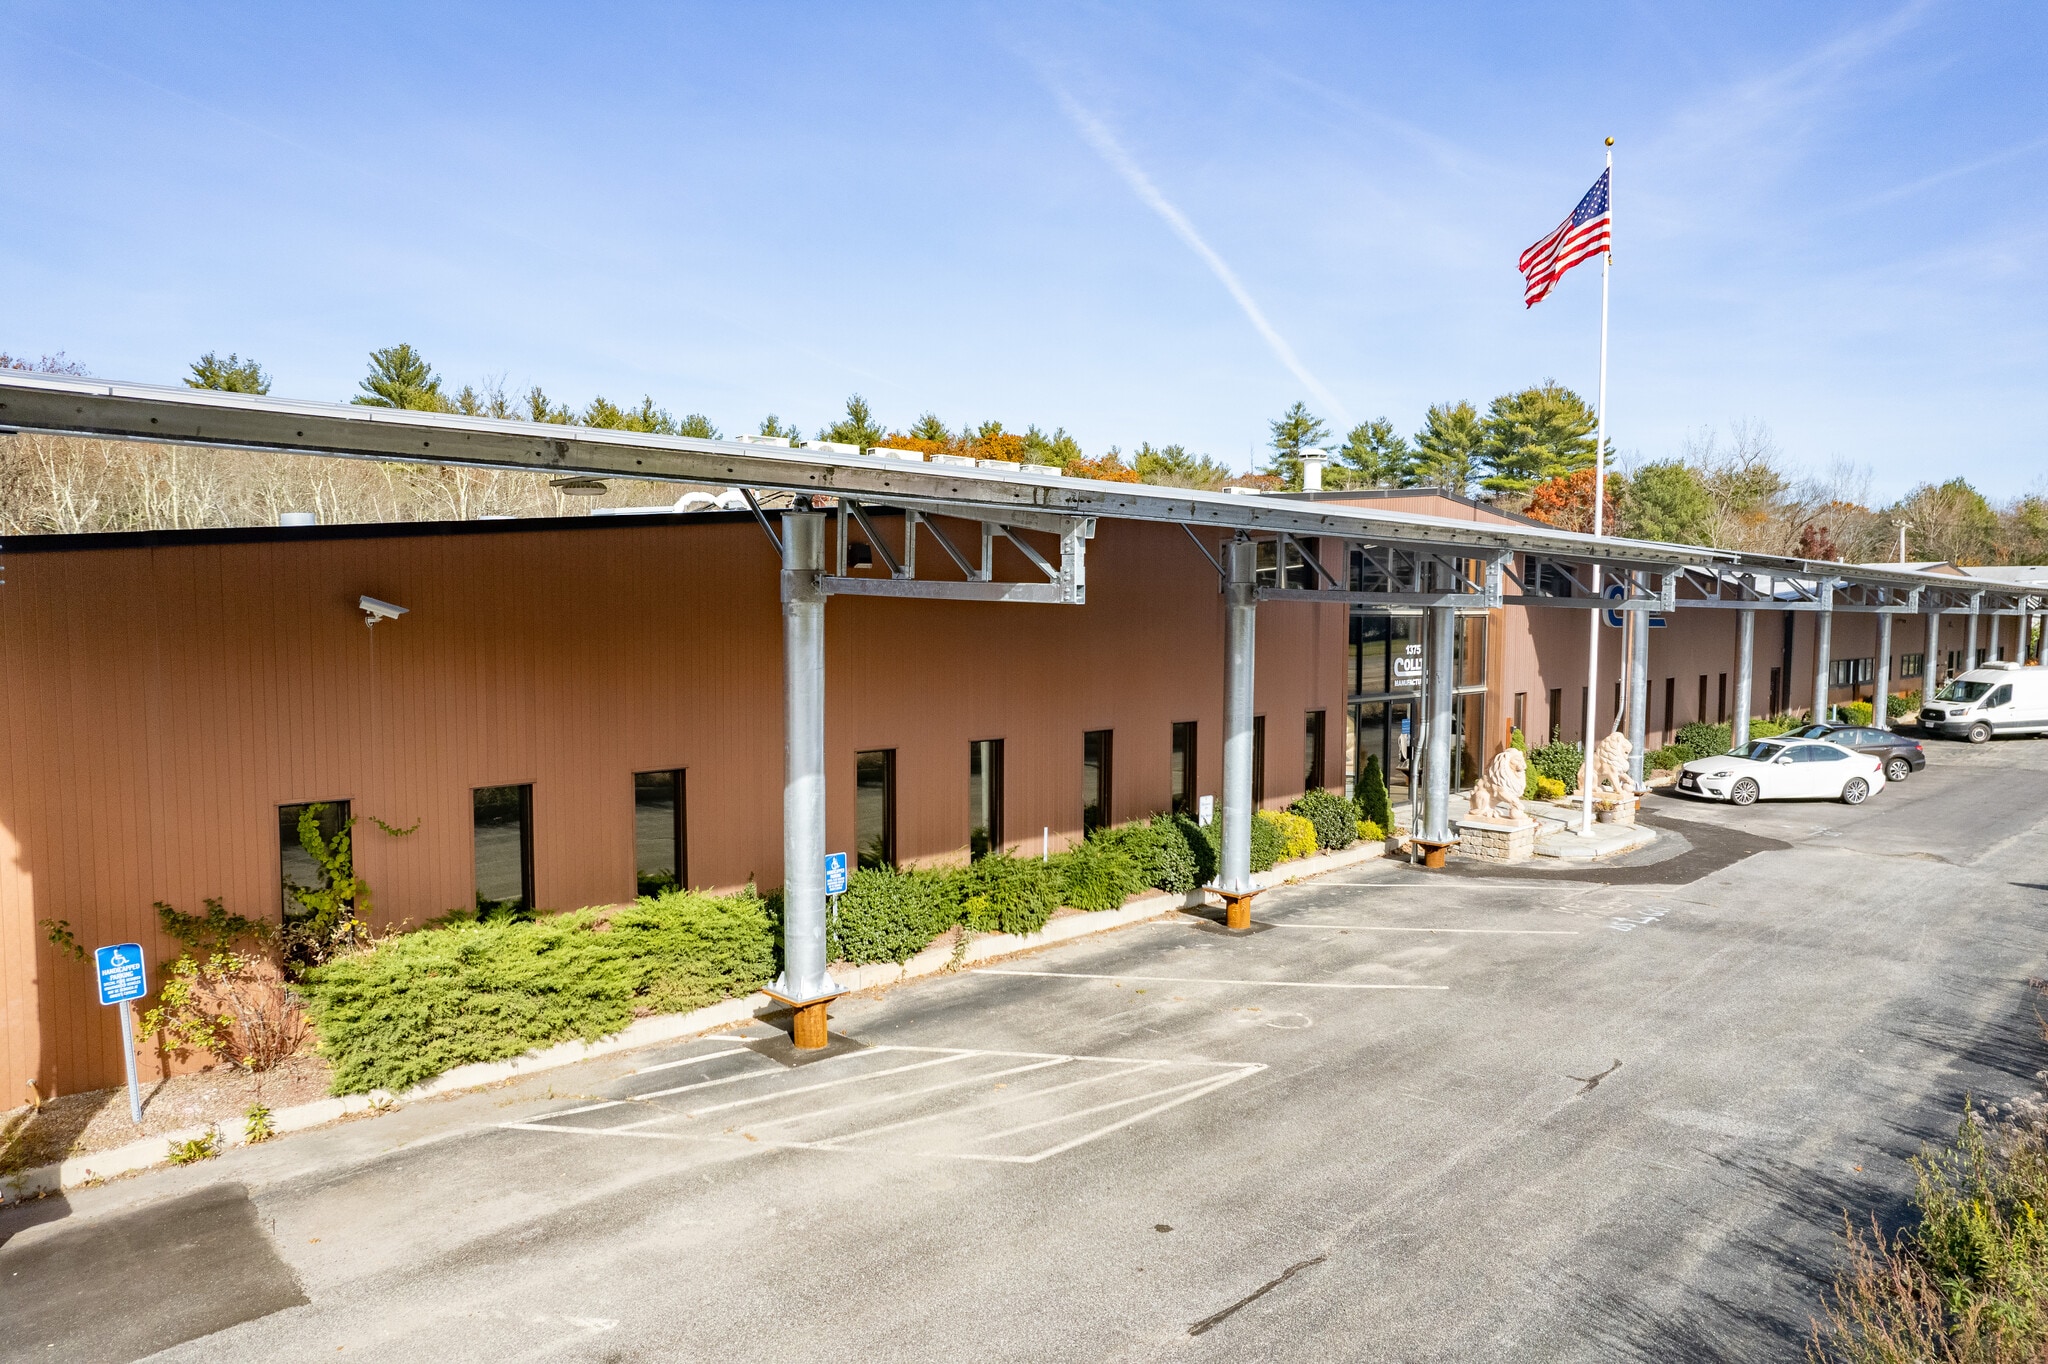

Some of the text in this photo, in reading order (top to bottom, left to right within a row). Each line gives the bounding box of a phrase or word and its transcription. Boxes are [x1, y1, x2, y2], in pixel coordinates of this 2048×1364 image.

[1406, 644, 1421, 655] 1375
[1394, 679, 1422, 687] MANUFACTU
[102, 963, 140, 976] HANDICAPPED
[110, 971, 134, 981] PARKING
